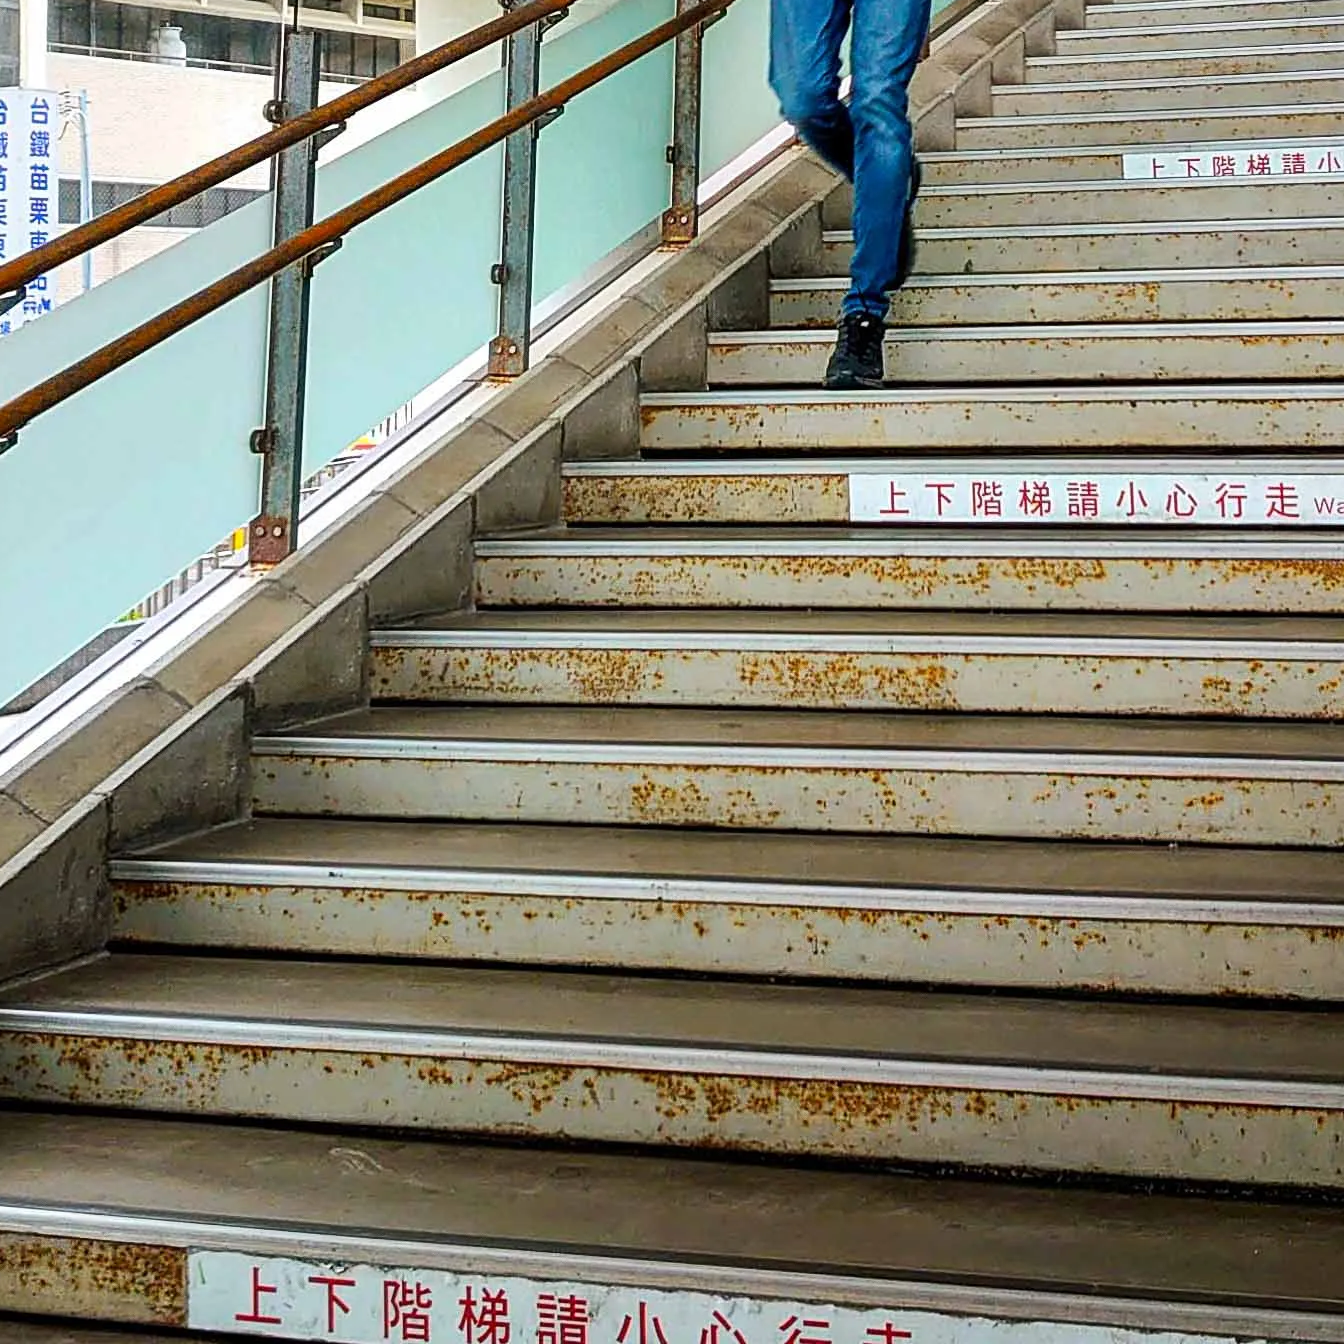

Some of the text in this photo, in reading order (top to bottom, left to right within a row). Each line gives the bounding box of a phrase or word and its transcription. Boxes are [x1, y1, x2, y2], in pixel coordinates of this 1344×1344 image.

[878, 481, 1301, 518] 上下階梯請小心行走
